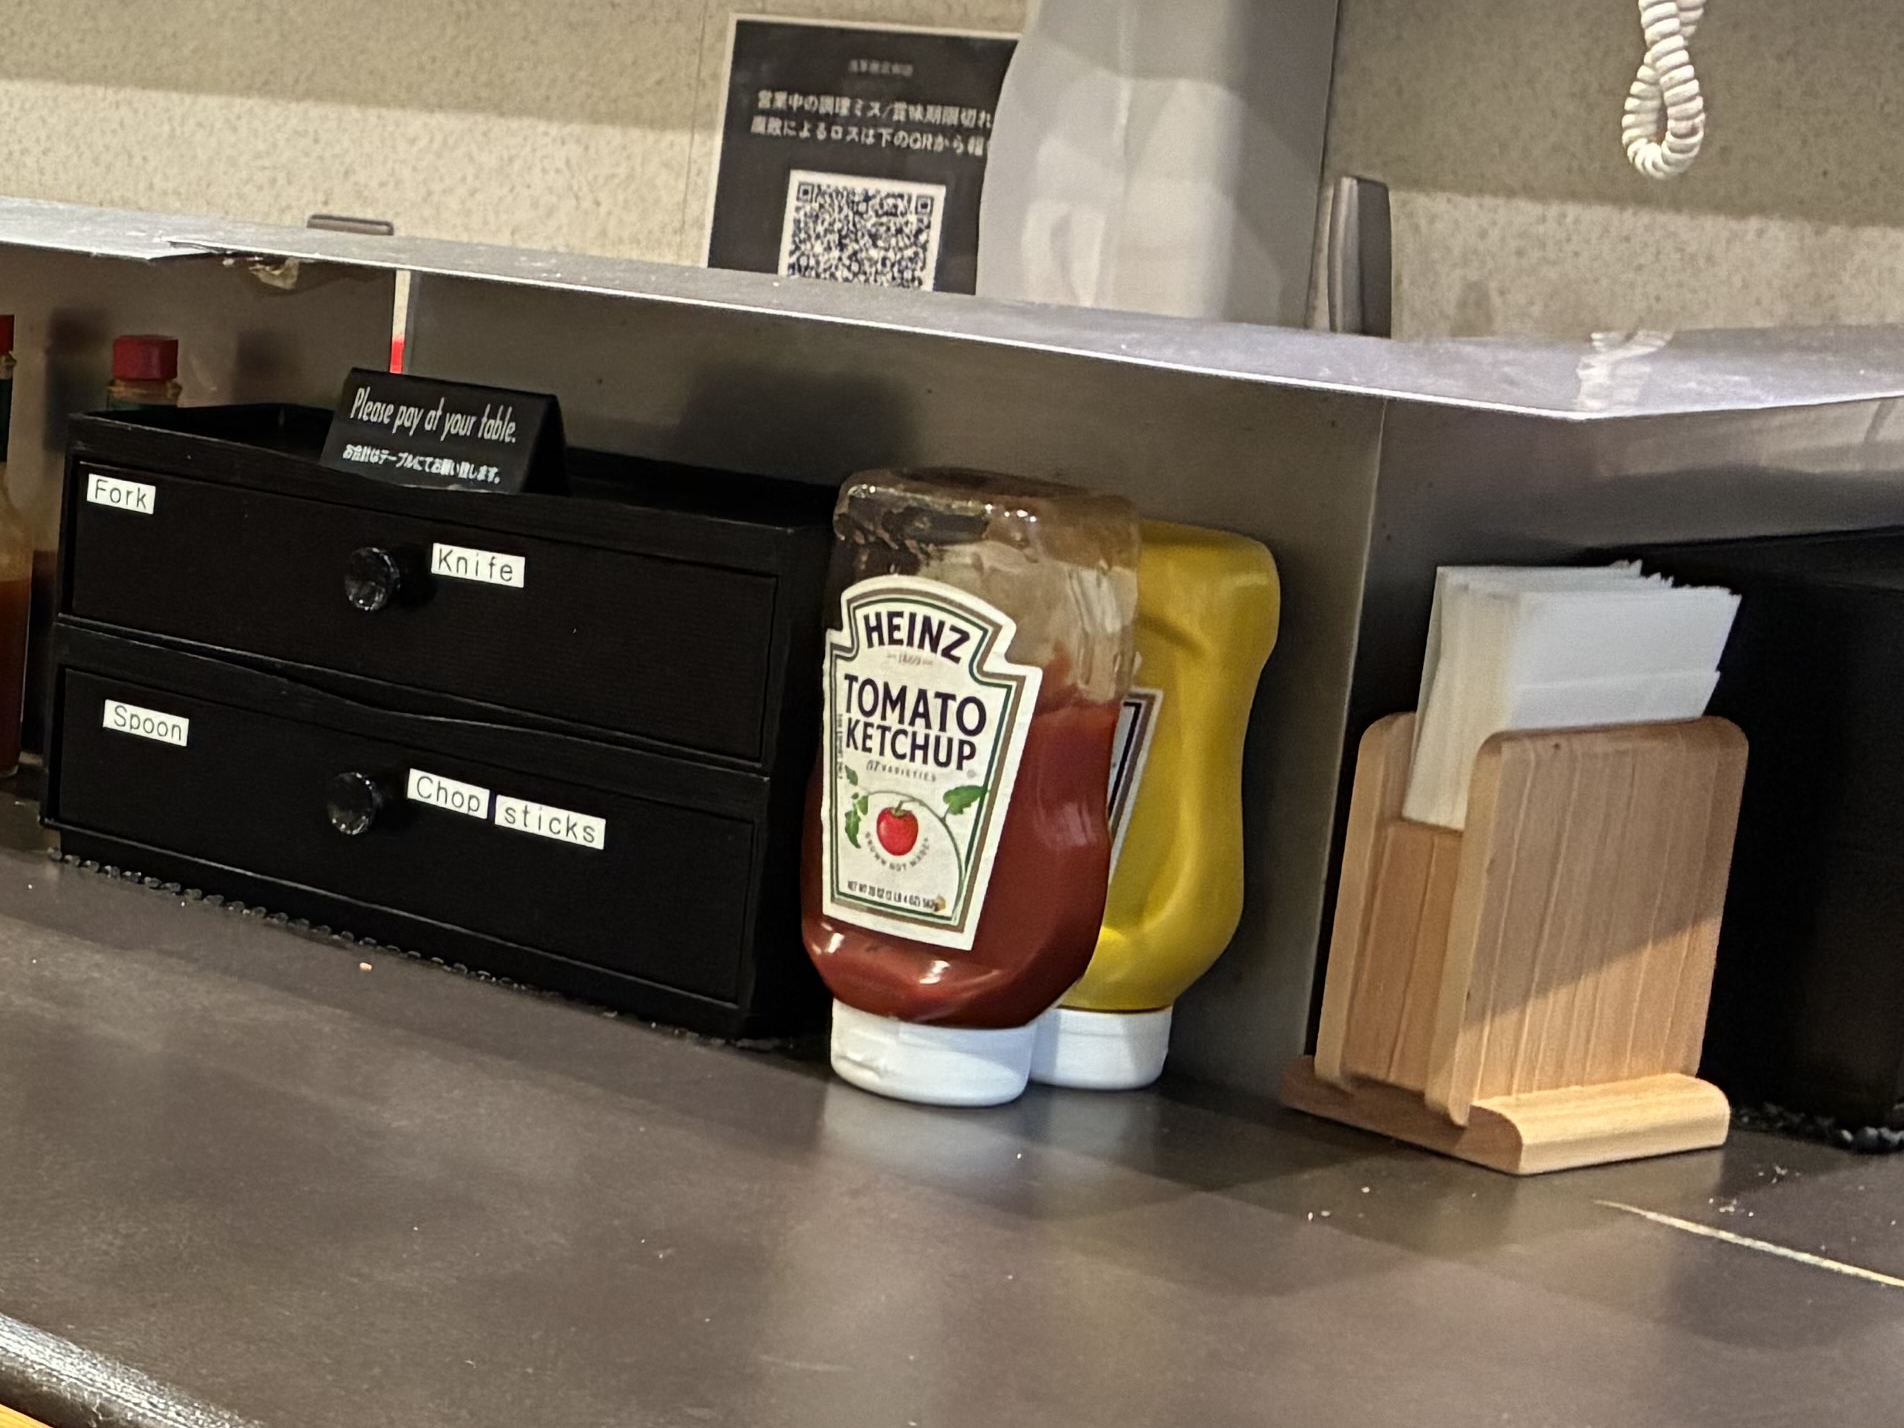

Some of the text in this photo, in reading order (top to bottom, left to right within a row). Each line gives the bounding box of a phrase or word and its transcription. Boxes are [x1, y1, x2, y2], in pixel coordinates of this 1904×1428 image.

[350, 386, 517, 444] Please pay at your table.
[93, 478, 148, 511] Fork
[437, 547, 514, 584] Knife
[863, 610, 971, 665] HEINZ
[113, 705, 183, 742] Spoon
[843, 673, 987, 737] TOMATO
[845, 716, 977, 771] KETCHUP
[415, 776, 597, 845] Chop sticks
